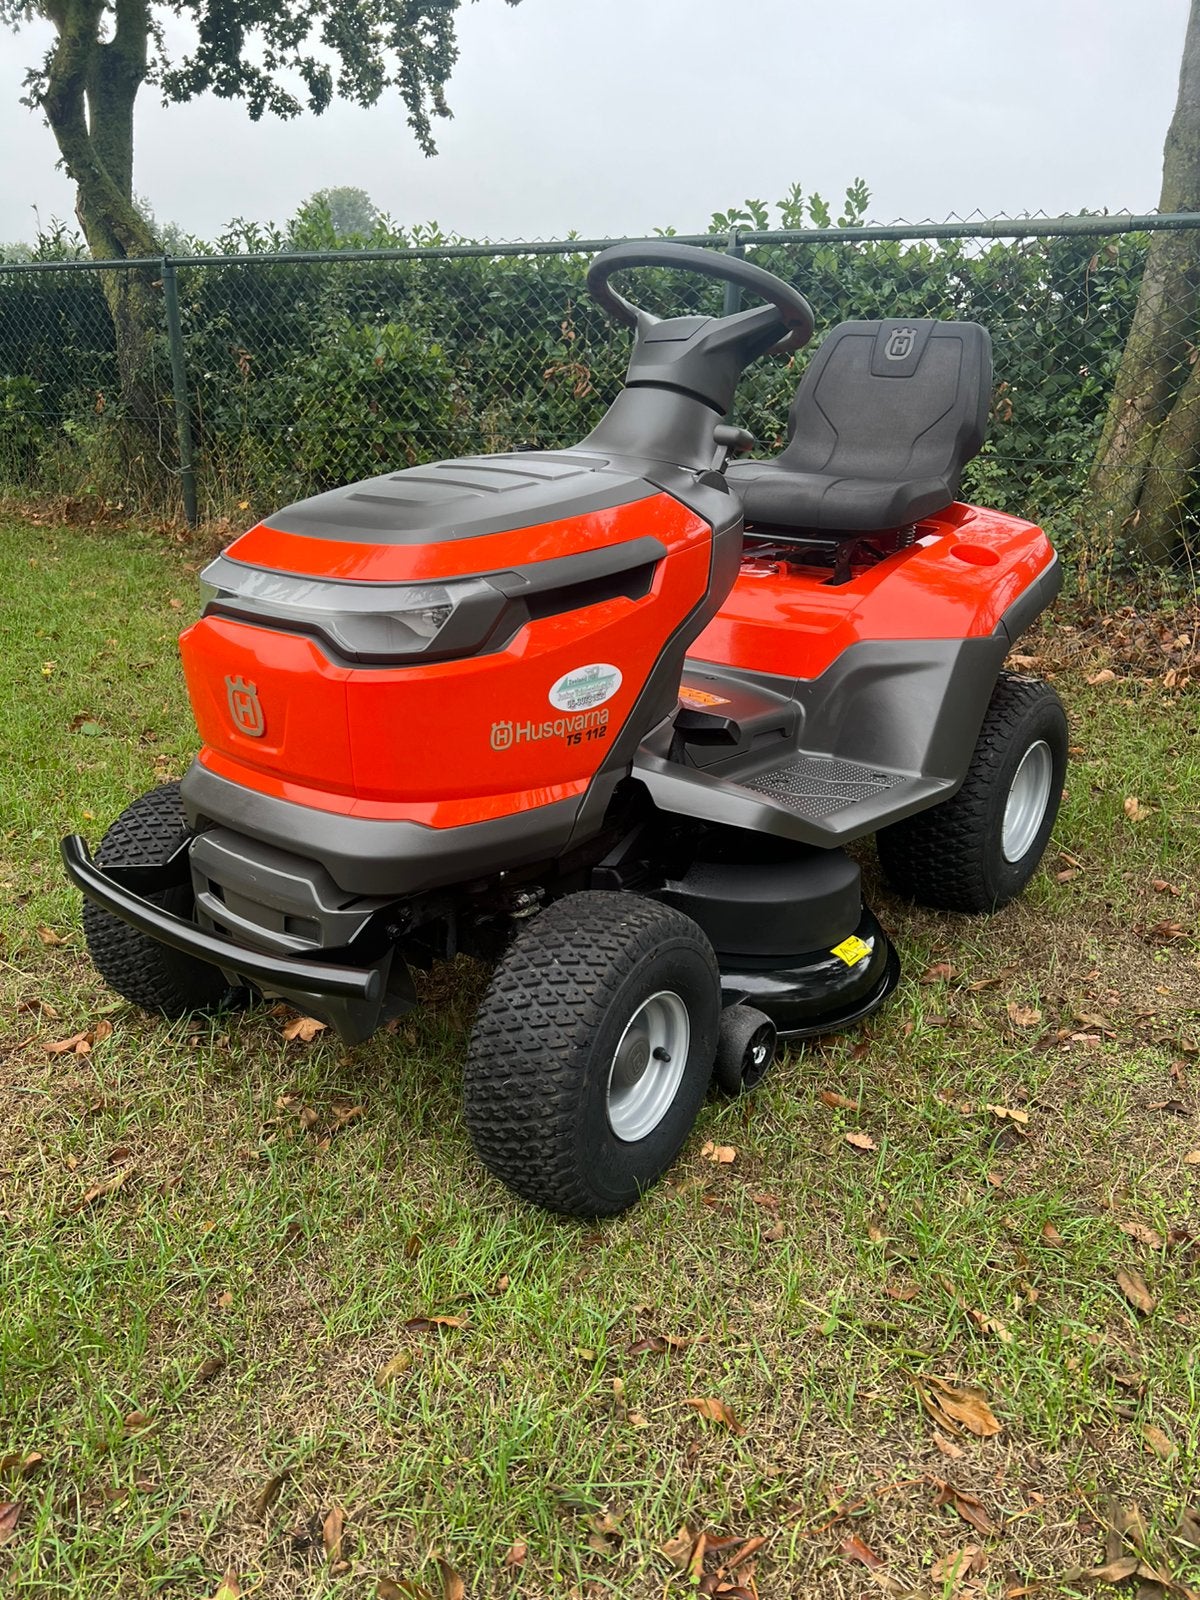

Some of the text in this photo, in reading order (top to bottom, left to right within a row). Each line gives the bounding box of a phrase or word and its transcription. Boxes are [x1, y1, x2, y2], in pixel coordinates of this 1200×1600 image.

[516, 708, 609, 743] Husqvarna
[566, 726, 607, 746] TS 112
